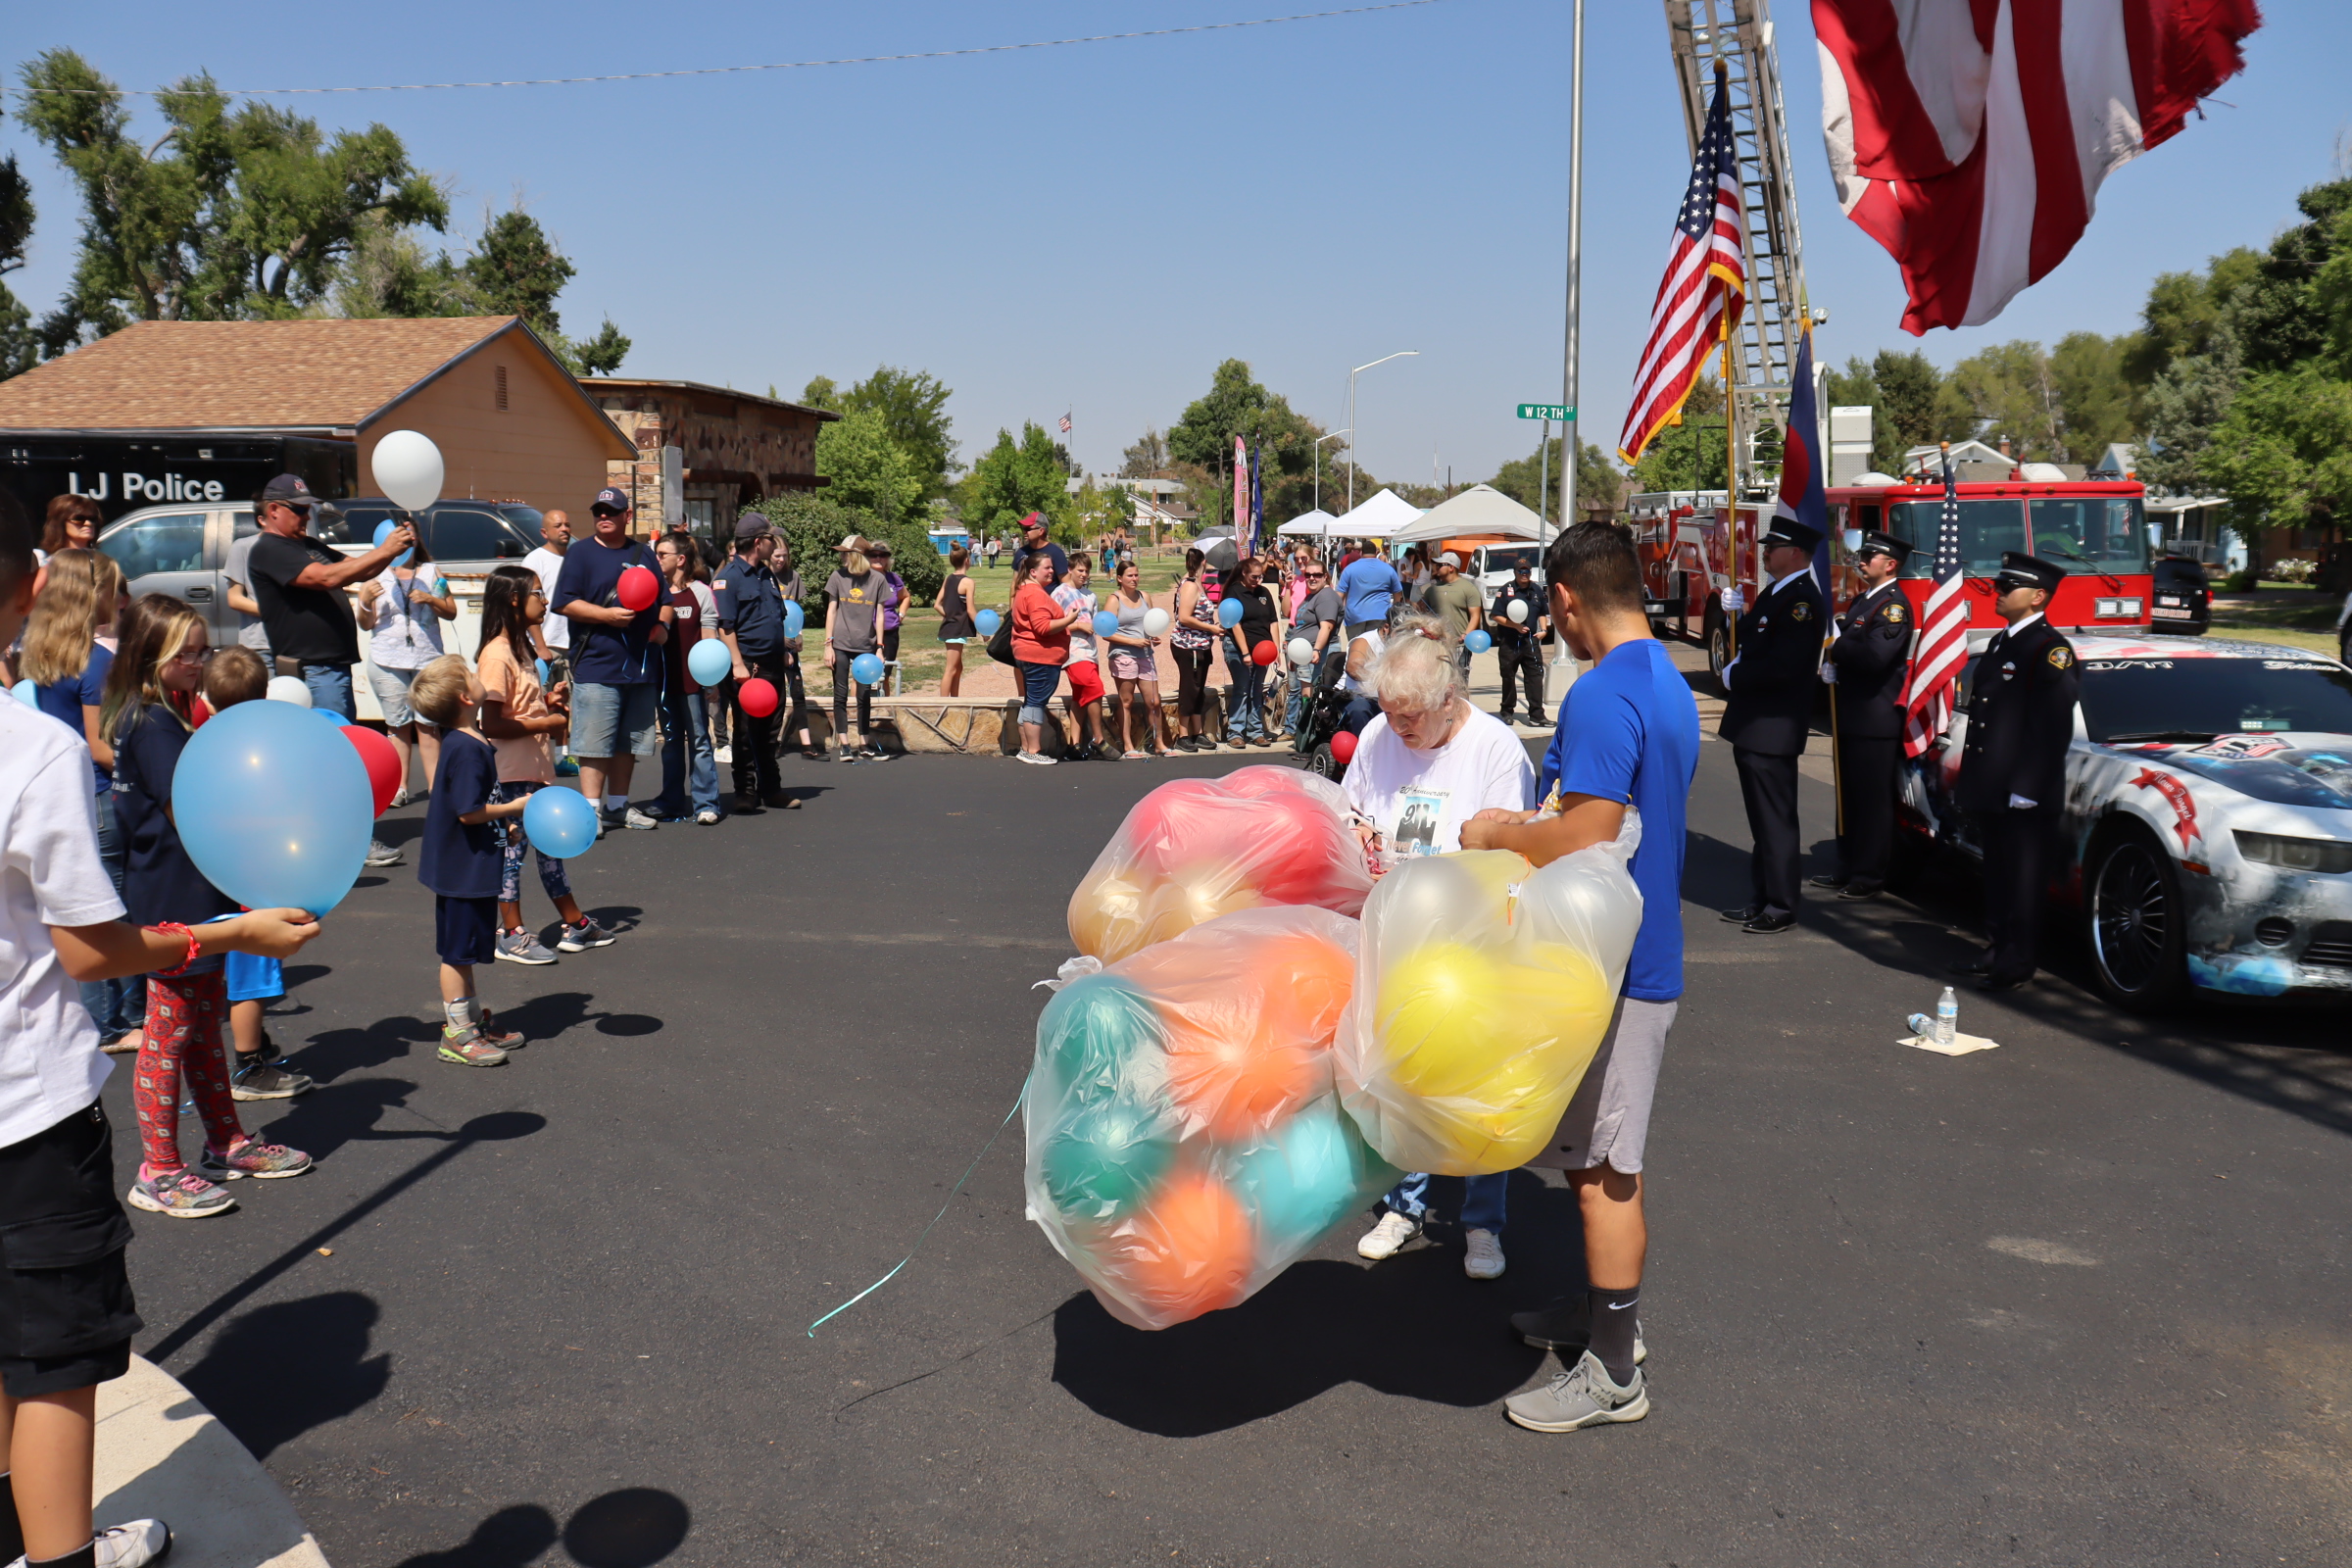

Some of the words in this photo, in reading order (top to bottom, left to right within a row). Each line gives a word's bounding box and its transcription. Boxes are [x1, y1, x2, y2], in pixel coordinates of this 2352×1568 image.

[1525, 406, 1534, 417] W
[1537, 406, 1547, 418] 12
[1550, 407, 1564, 419] TH
[69, 471, 109, 501] LJ
[122, 472, 224, 501] Police
[2154, 771, 2176, 793] Never
[2172, 788, 2193, 821] Forget
[1386, 839, 1411, 853] Never
[1412, 842, 1443, 857] Forget
